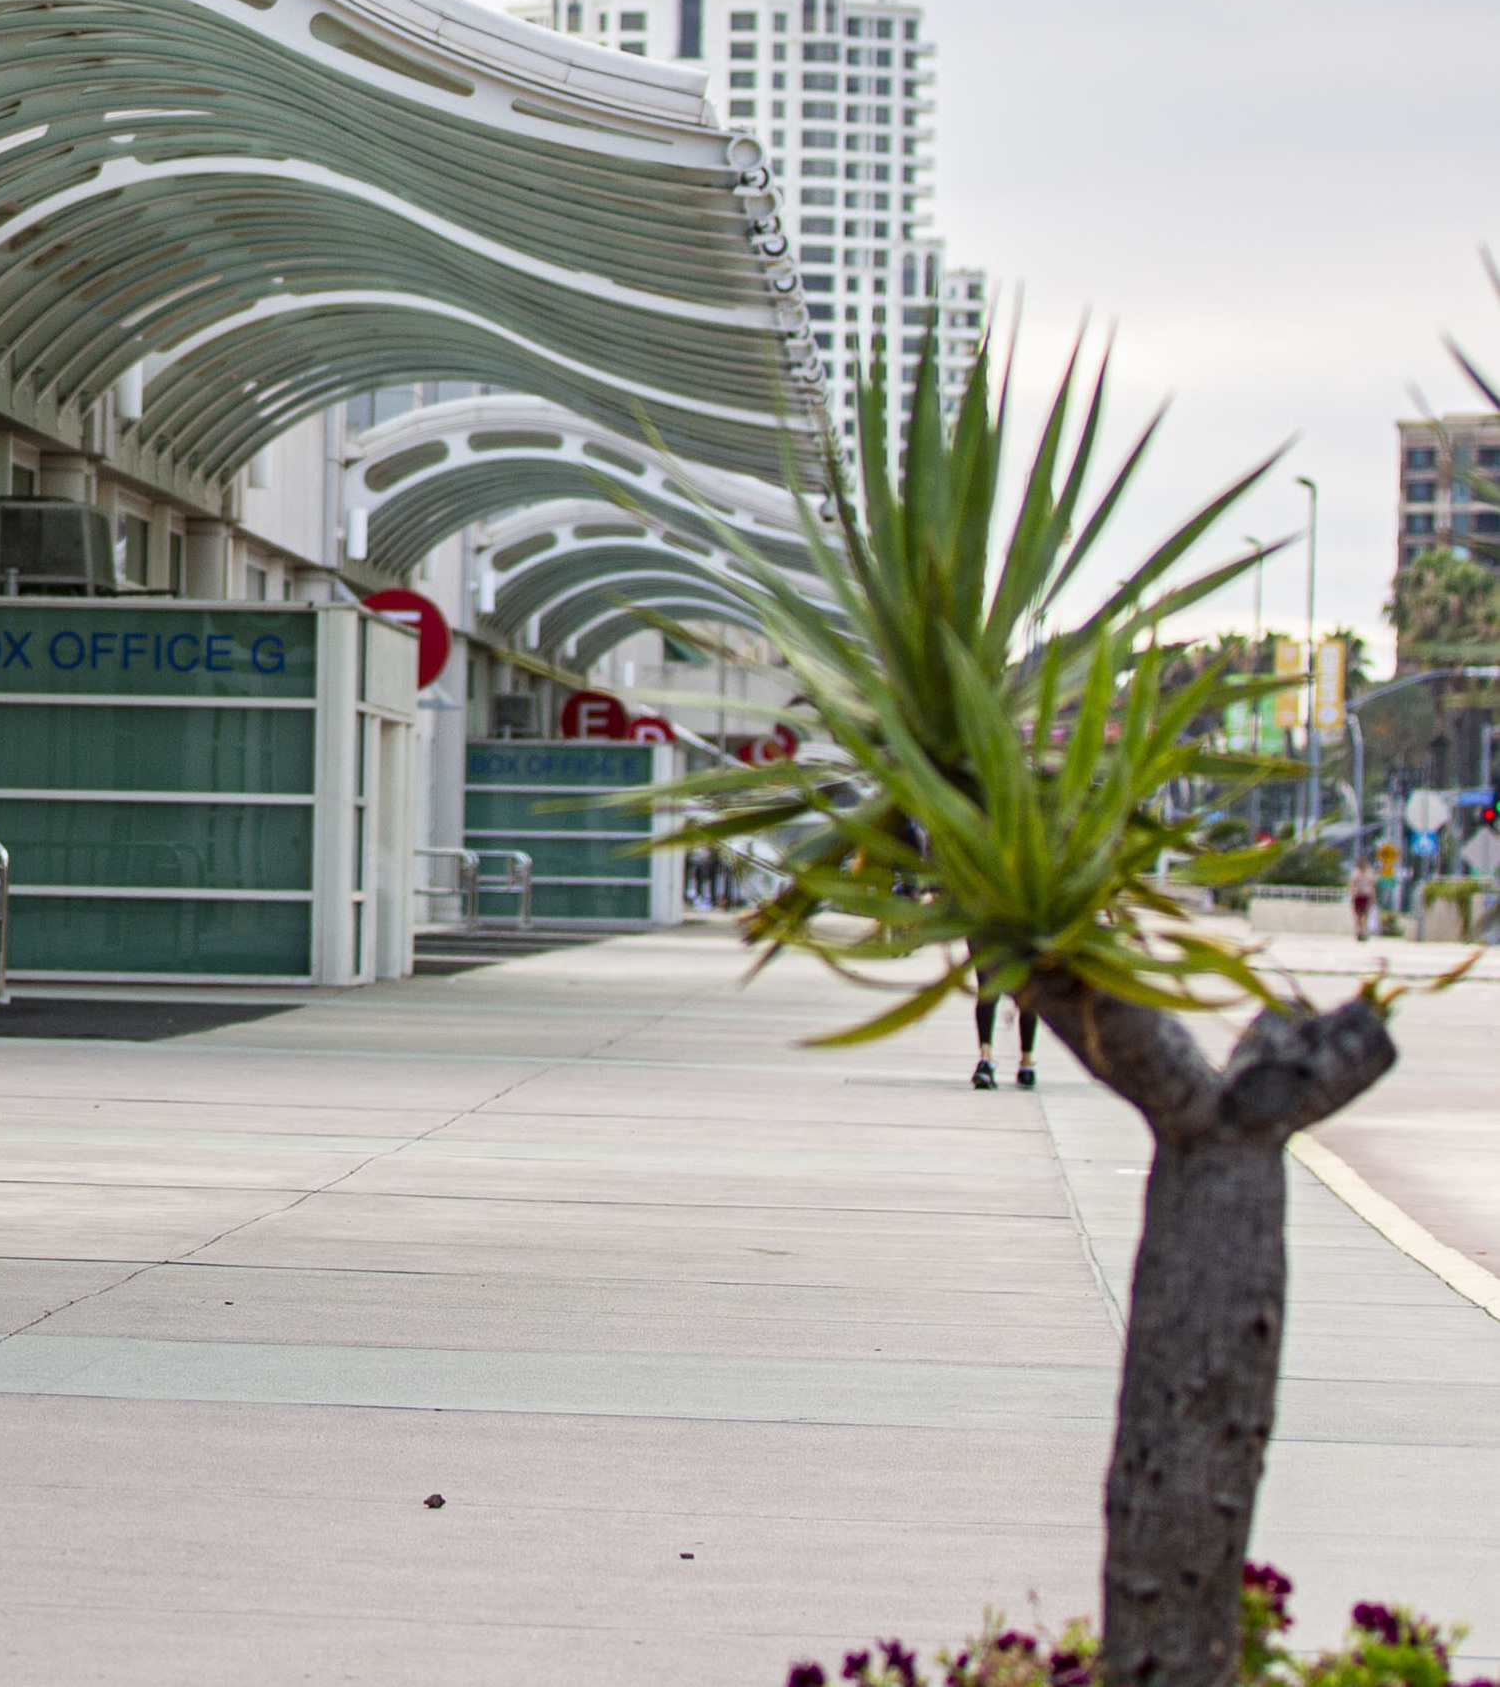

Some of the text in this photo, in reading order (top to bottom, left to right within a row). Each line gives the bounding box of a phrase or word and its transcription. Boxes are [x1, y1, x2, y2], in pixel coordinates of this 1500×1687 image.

[49, 631, 234, 673] OFFICE
[251, 634, 285, 675] G
[579, 702, 611, 740] E
